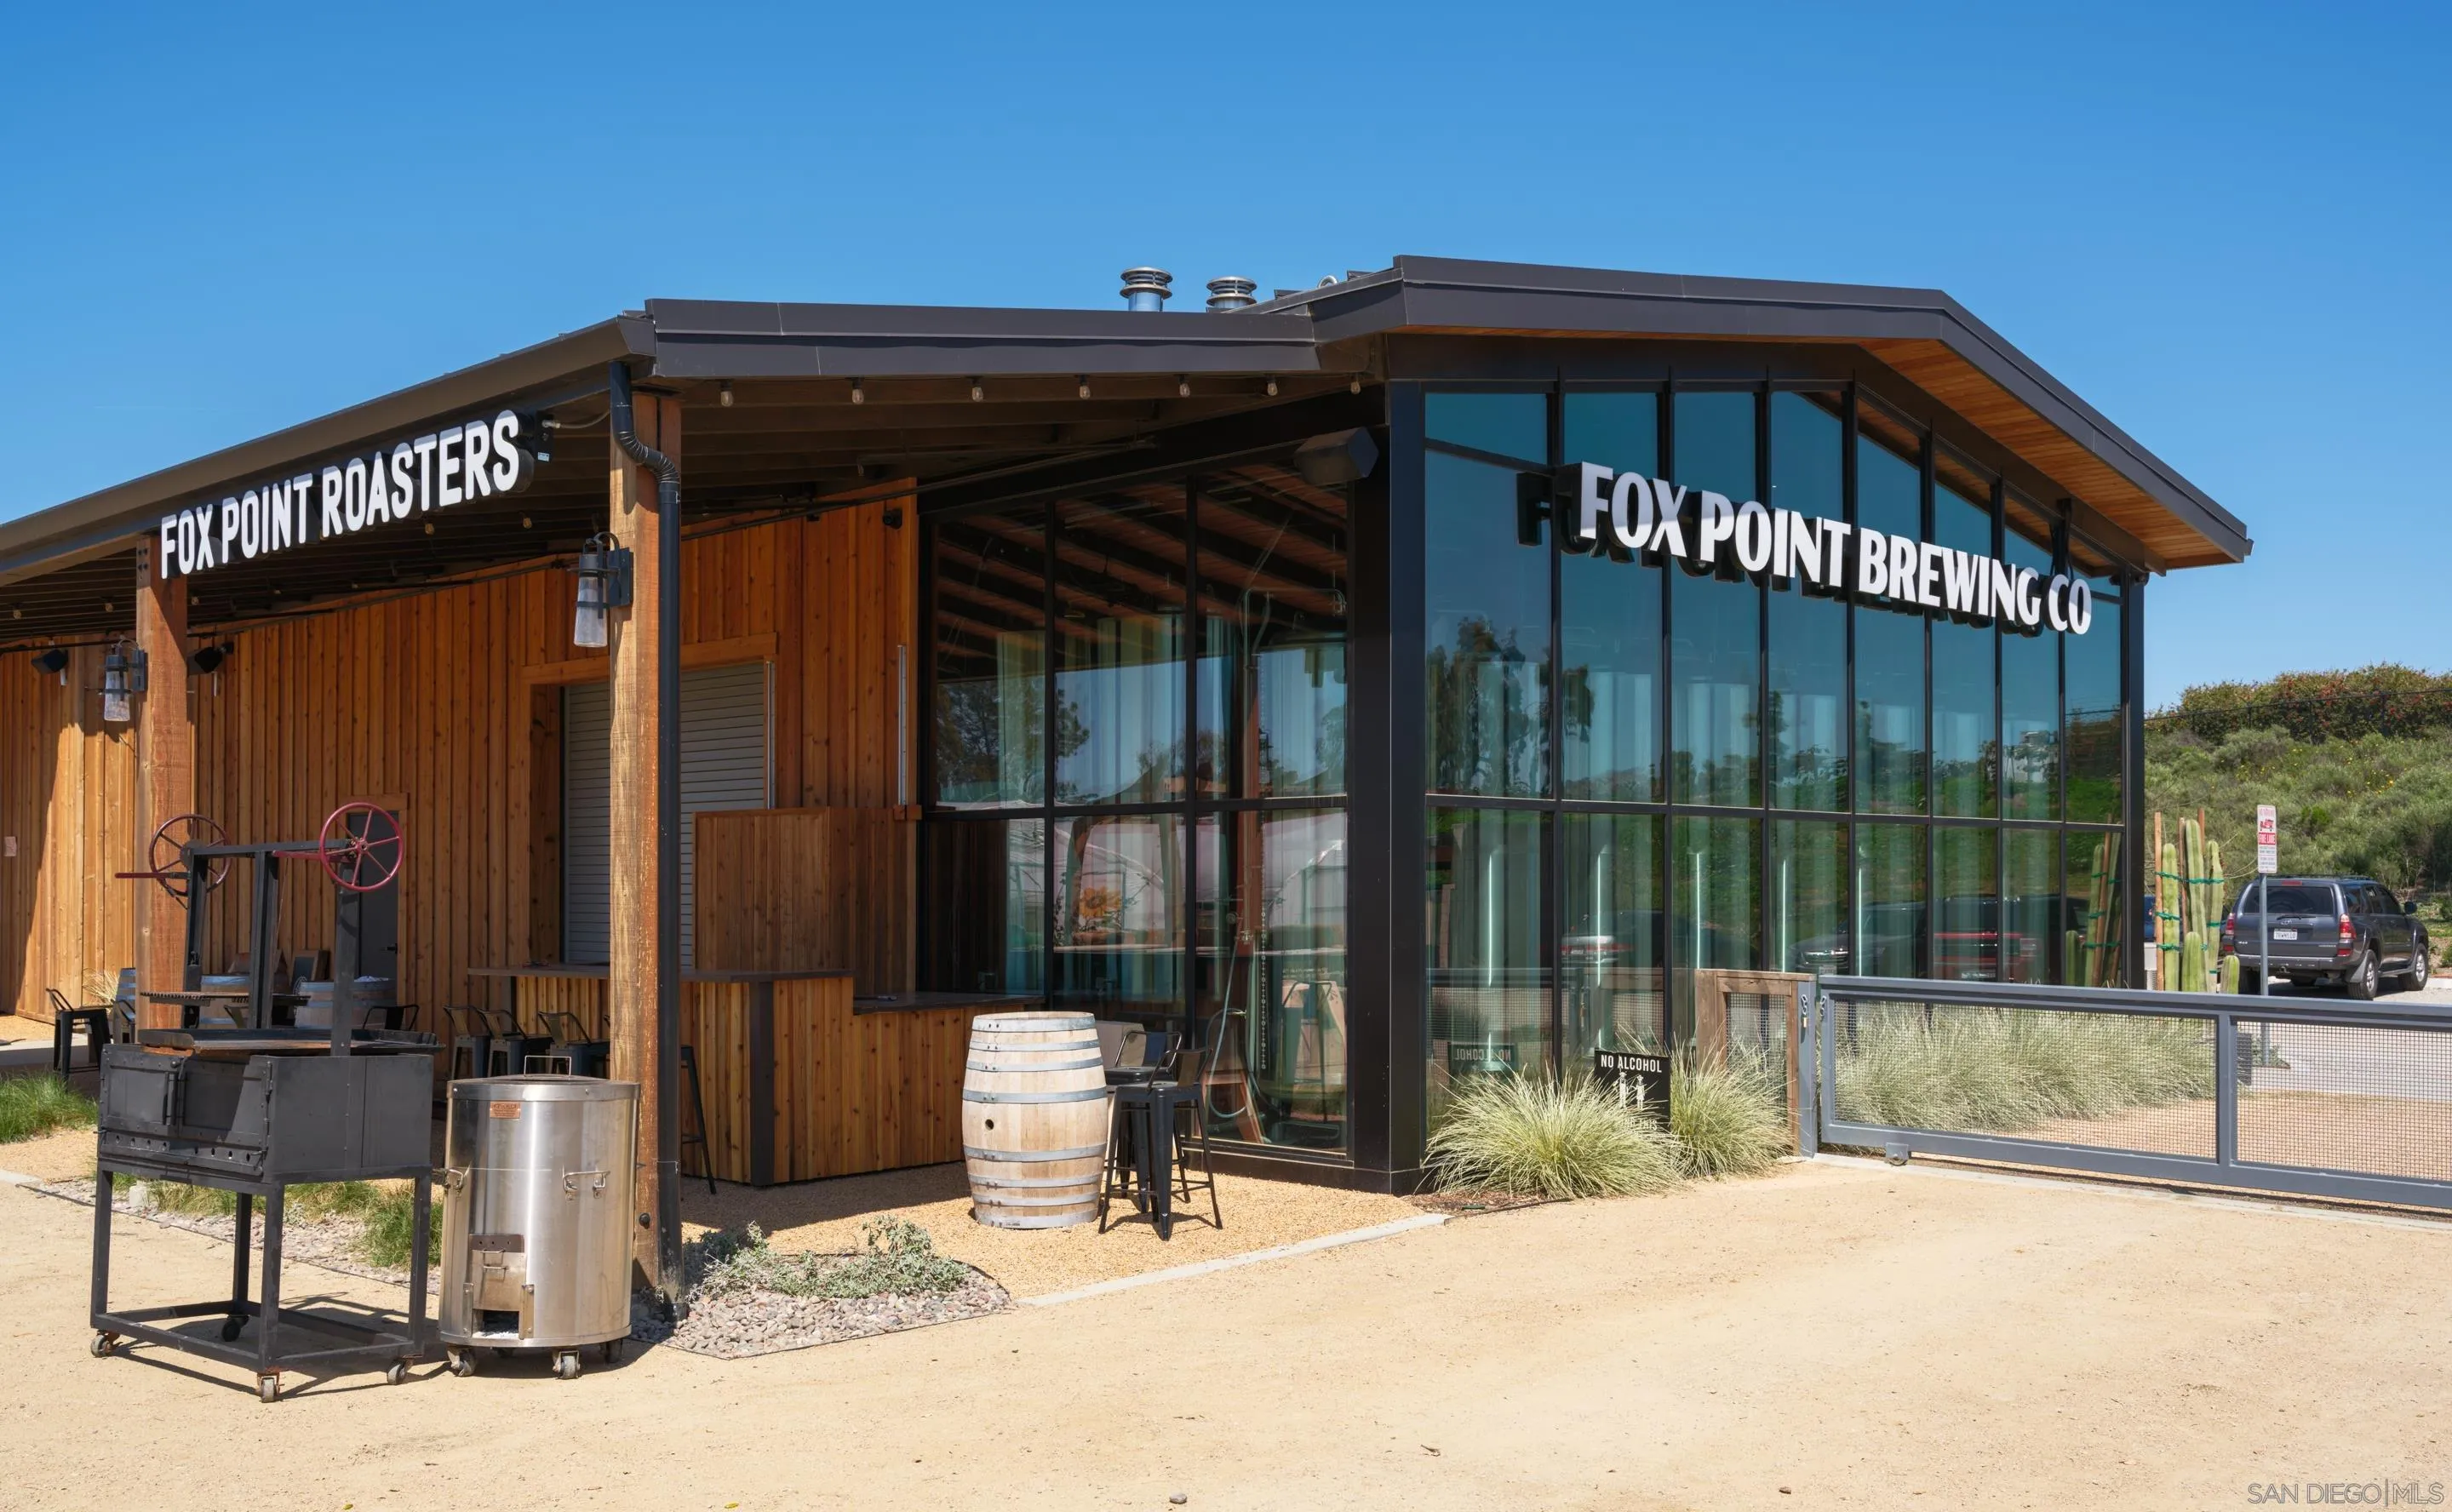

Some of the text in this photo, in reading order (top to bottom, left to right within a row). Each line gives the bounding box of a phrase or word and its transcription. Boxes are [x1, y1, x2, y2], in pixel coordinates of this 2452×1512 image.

[161, 410, 520, 580] FOX POINT ROASTERS
[1579, 461, 2092, 636] FOX POINT BREWING CO
[1601, 1054, 1663, 1074] NO ALCOHOL
